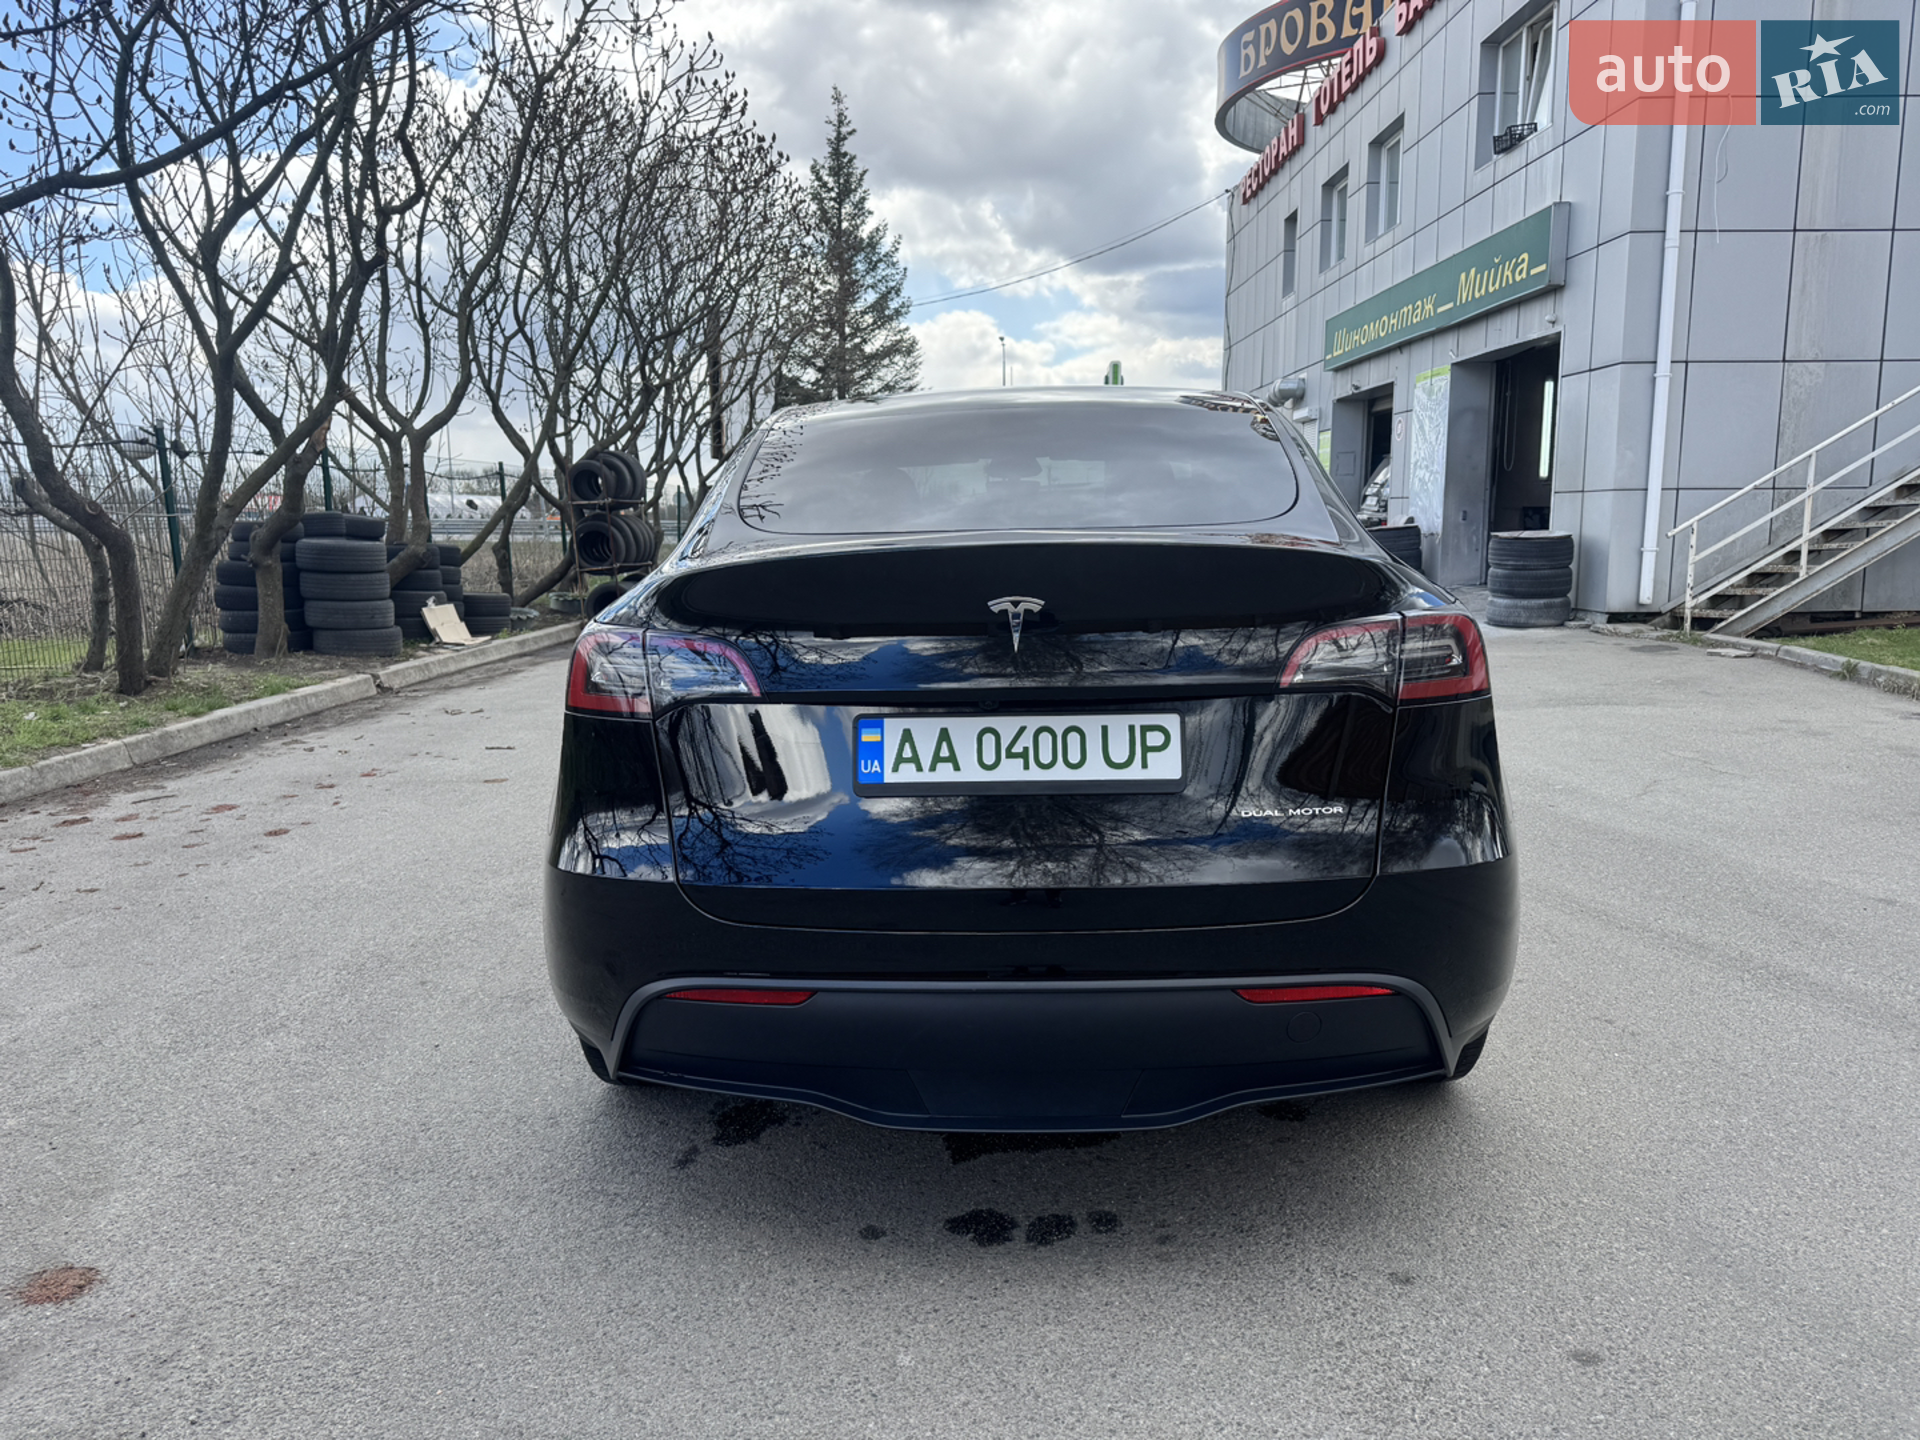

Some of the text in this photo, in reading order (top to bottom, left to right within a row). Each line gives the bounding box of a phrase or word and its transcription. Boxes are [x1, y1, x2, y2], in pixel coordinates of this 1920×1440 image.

[1240, 113, 1300, 204] РЕСТОРАН
[1312, 26, 1380, 126] ГОТЕЛЬ
[891, 724, 1171, 773] AA 0400 UP
[861, 760, 882, 773] UA
[1241, 806, 1344, 818] DUAL MOTOR
